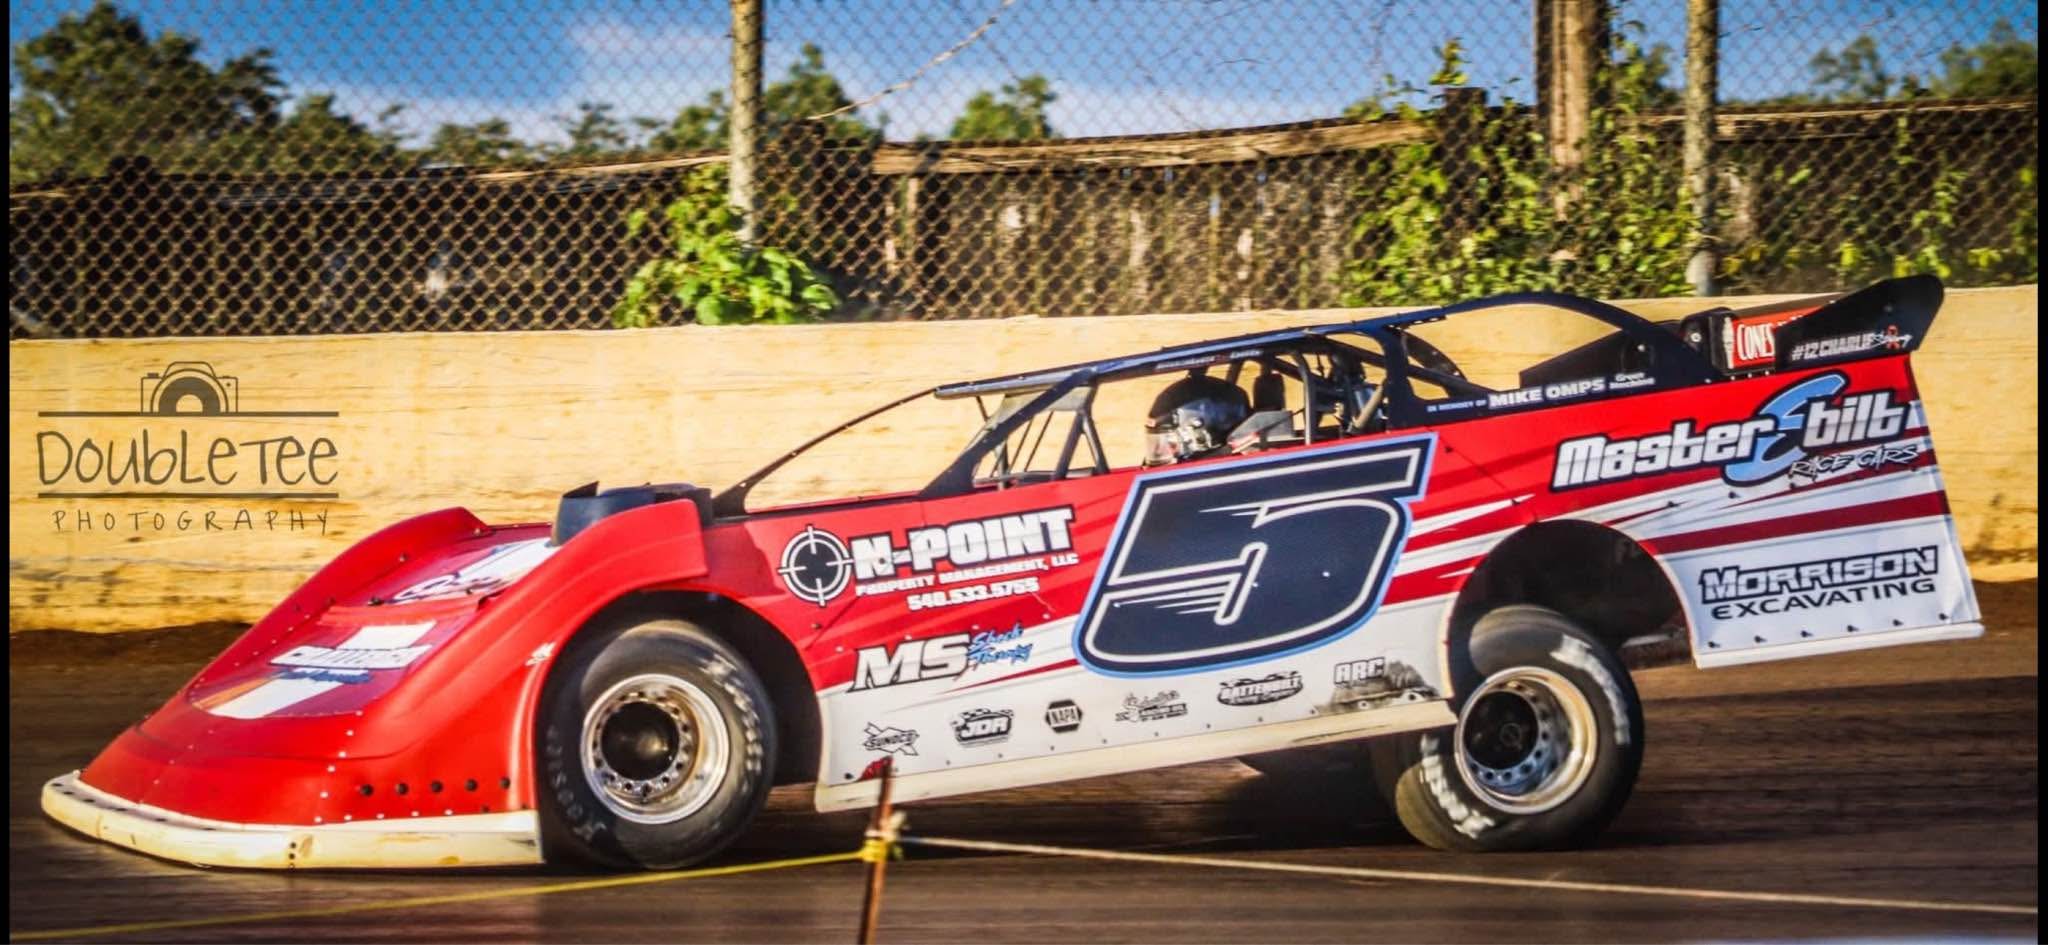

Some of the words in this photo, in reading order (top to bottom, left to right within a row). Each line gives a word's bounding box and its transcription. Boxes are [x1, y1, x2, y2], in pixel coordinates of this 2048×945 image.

[1488, 387, 1543, 409] MIKE
[1545, 379, 1605, 399] OMPS
[1790, 454, 1852, 482] RACE
[1854, 443, 1919, 471] CARS
[1050, 553, 1080, 567] LLC
[1074, 433, 1437, 678] 5
[1699, 545, 1939, 604] MORRISON
[1711, 577, 1936, 621] EXCAVATING
[847, 631, 971, 693] MS
[1334, 656, 1386, 686] ARC
[1051, 708, 1077, 724] NAPA
